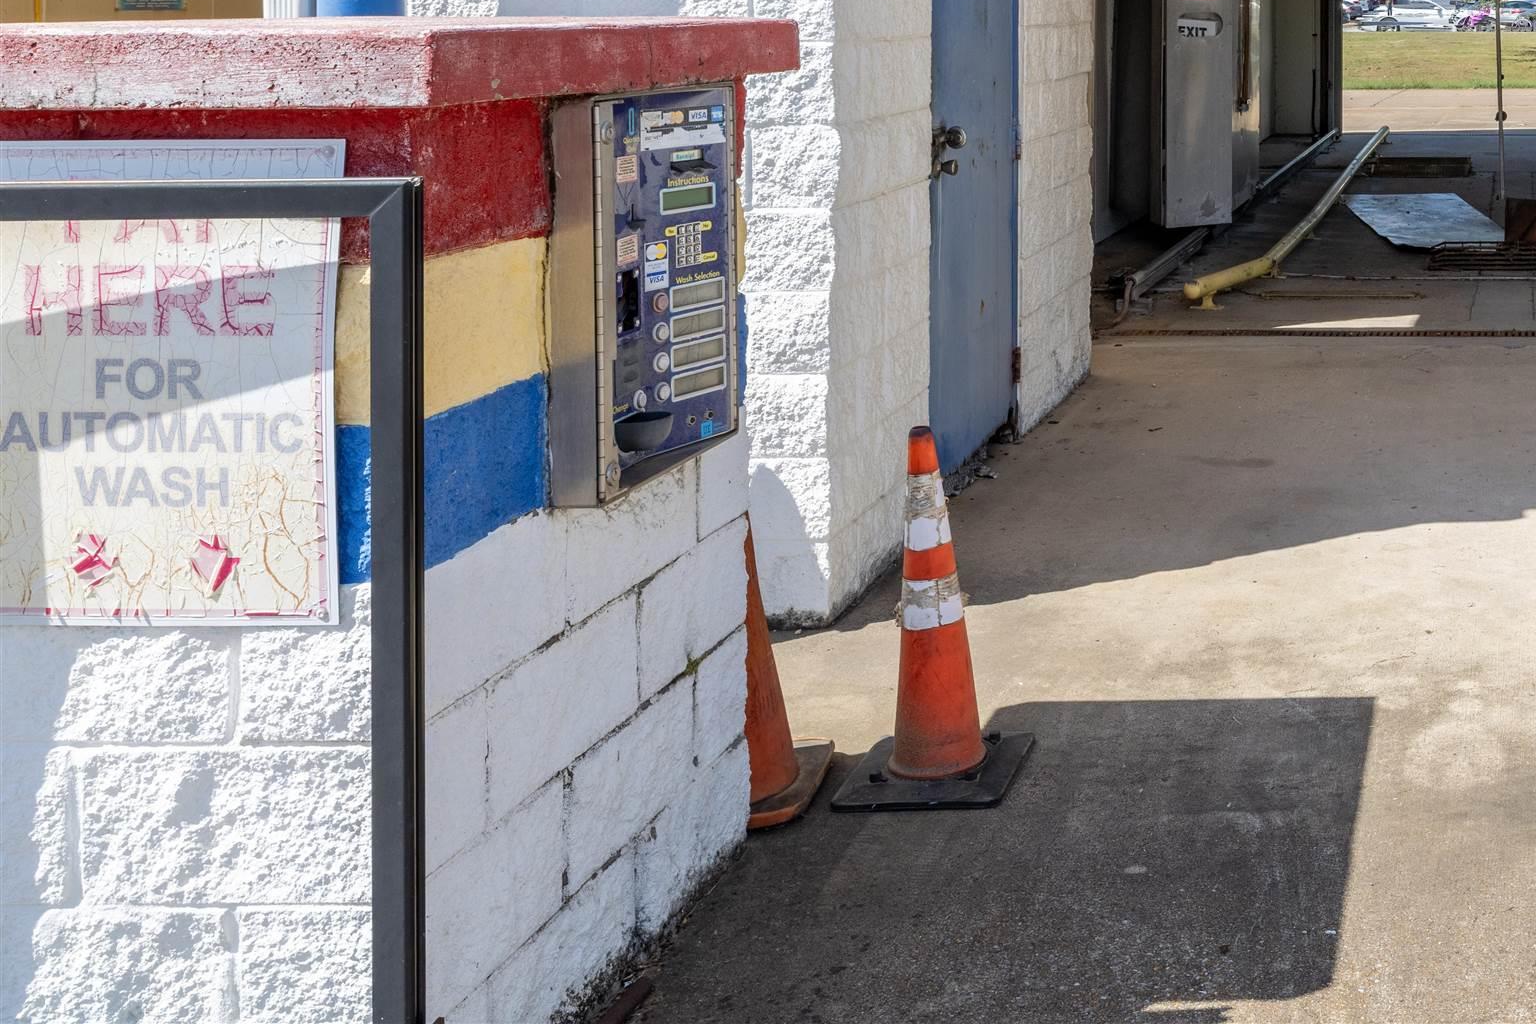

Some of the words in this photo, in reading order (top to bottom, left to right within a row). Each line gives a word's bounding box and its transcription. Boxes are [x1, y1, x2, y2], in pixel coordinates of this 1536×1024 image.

[1178, 26, 1208, 37] EXIT
[690, 111, 707, 120] VISA
[667, 175, 710, 187] Instructions
[650, 275, 665, 284] VISA
[675, 275, 693, 284] Wash
[694, 270, 720, 281] Selection
[24, 264, 275, 337] HERE
[95, 358, 204, 400] FOR
[0, 411, 303, 454] AUTOMATIC
[75, 465, 230, 508] WASH
